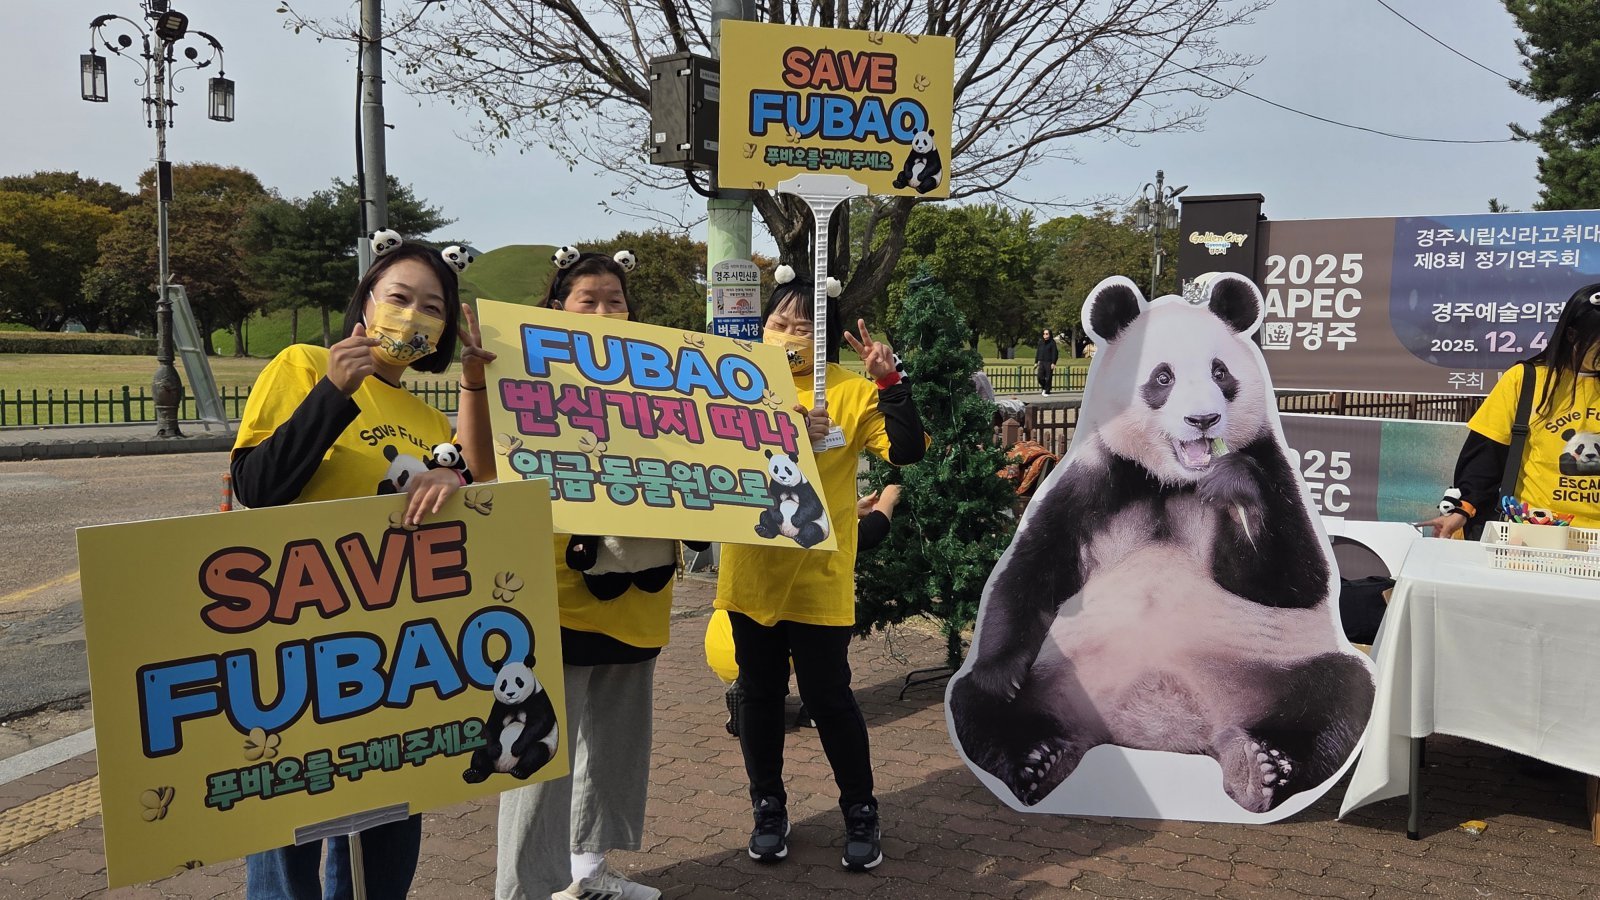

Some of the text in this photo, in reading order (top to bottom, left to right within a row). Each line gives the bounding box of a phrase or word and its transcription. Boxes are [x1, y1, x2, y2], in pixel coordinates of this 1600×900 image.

[782, 47, 897, 93] SAVE
[749, 89, 929, 145] FUBAO
[764, 146, 894, 171] 푸바오를 구해 주세요
[1189, 231, 1248, 247] Golden City
[1416, 224, 1600, 248] 경주시립신라고취대
[1264, 253, 1363, 285] 2025
[1414, 249, 1580, 270] 제8회 정기연주회
[714, 271, 758, 282] 경주시민신문
[1264, 287, 1362, 318] APEC
[1431, 301, 1567, 323] 경주예술의전
[717, 323, 760, 337] 벼룩시장
[1295, 322, 1358, 351] 경주
[1430, 339, 1479, 352] 2025.
[1485, 331, 1523, 353] 12.
[520, 323, 768, 404] FUBAO
[1447, 371, 1484, 391] 주최
[498, 378, 799, 455] 번식기지 떠나
[1545, 411, 1581, 434] Save
[360, 424, 431, 452] Save Fub
[1288, 447, 1352, 481] 25
[1305, 481, 1352, 513] EC
[1559, 476, 1600, 491] ESCA
[199, 520, 471, 634] SAVE
[136, 605, 536, 758] FUBAO
[203, 717, 489, 812] 푸바오를 구해 주세요
